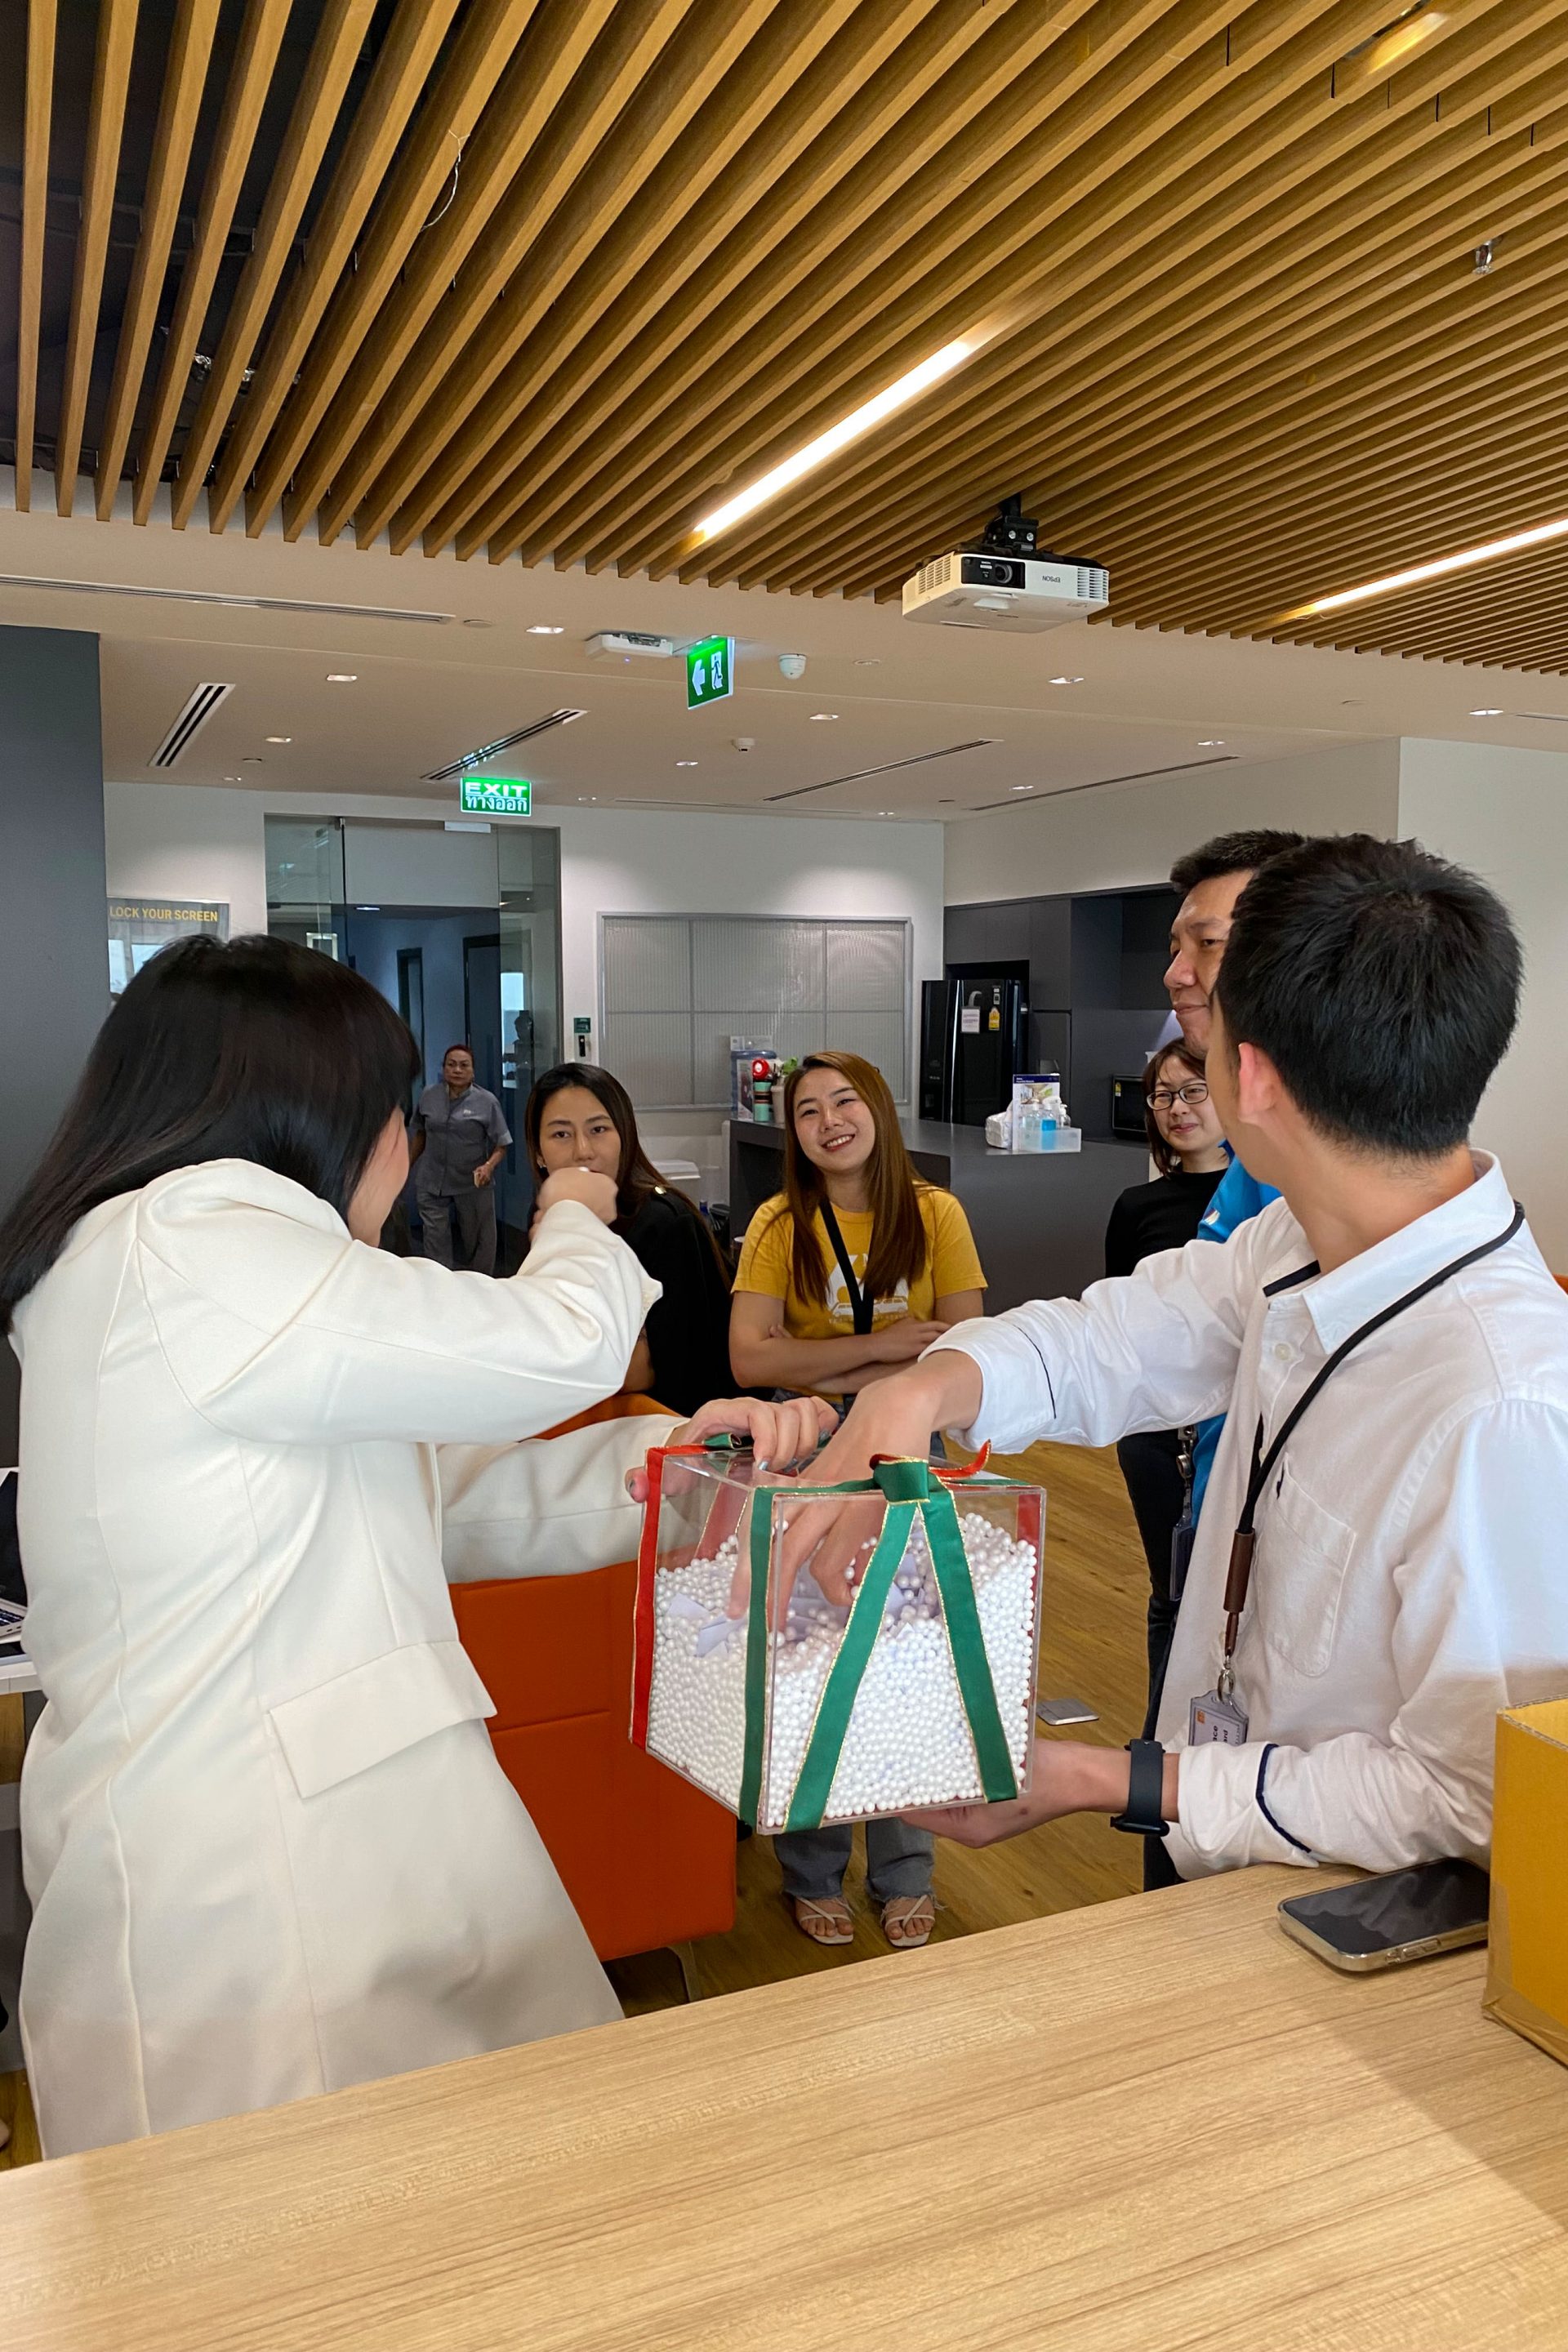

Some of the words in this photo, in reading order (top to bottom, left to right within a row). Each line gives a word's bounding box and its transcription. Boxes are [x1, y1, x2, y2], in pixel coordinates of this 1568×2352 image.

[1042, 575, 1061, 583] EPSON
[466, 782, 528, 798] EXIT
[466, 796, 528, 812] ทางออก
[109, 906, 140, 918] LOCK
[142, 908, 172, 920] YOUR
[175, 910, 218, 922] SCREEN
